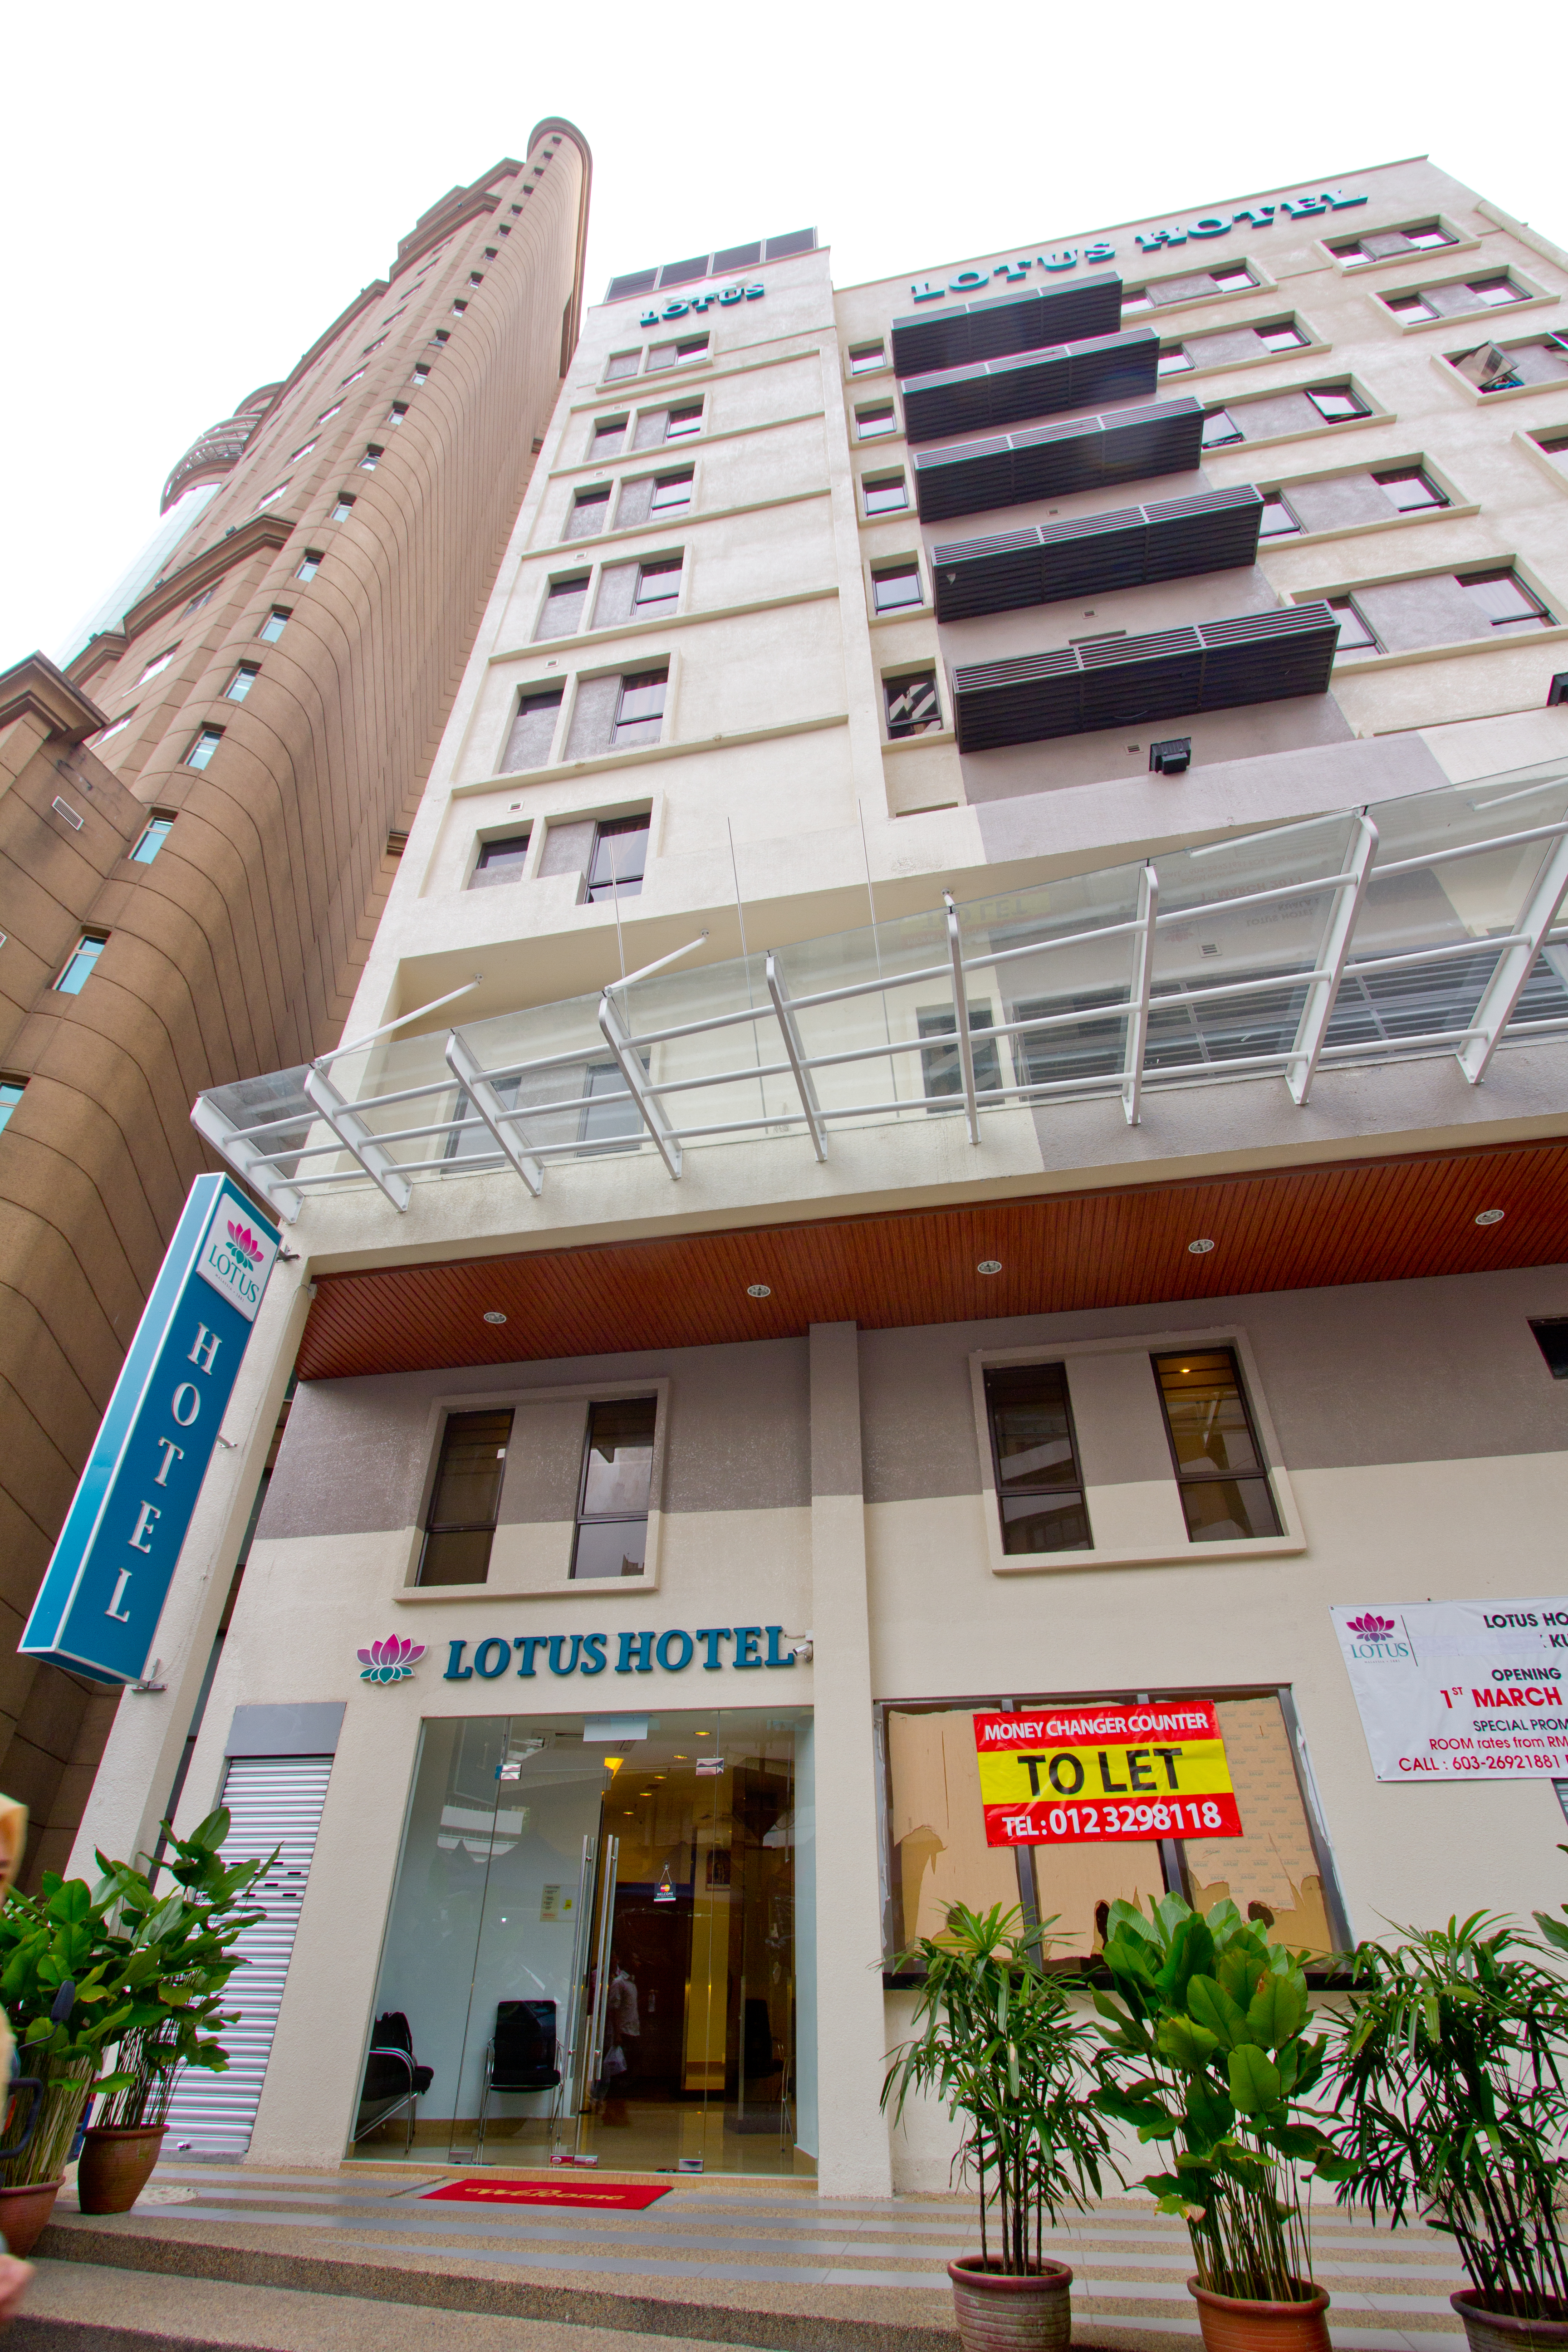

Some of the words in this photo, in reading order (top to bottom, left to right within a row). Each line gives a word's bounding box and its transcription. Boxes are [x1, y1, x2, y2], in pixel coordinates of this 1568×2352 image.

[911, 242, 1115, 304] LOTUS
[1135, 190, 1368, 253] HOTEL
[640, 284, 764, 328] LOTUS
[208, 1243, 260, 1303] LOTUS
[216, 1274, 233, 1291] MALAYSIA
[104, 1322, 223, 1622] HOTEL
[1483, 1613, 1538, 1628] LOTUS
[443, 1633, 607, 1680] LOTUS
[614, 1625, 795, 1672] HOTEL
[1350, 1642, 1408, 1658] LOTUS
[1492, 1667, 1561, 1681] OPENING
[1440, 1687, 1463, 1709] 1ST
[1471, 1686, 1563, 1707] MARCH
[985, 1721, 1043, 1740] MONEY
[1047, 1717, 1127, 1737] CHANGER
[1128, 1713, 1209, 1733] COUNTER
[1473, 1720, 1529, 1731] SPECIAL
[1429, 1738, 1474, 1750] ROOM
[1477, 1737, 1510, 1749] rates
[1513, 1736, 1544, 1748] from
[1547, 1736, 1568, 1747] RM
[1017, 1753, 1084, 1797] TO
[1098, 1748, 1182, 1793] LET
[1399, 1757, 1439, 1771] CALL
[1452, 1754, 1560, 1770] 603-26921881
[1049, 1807, 1100, 1836] 012
[1104, 1802, 1222, 1832] 3298118
[465, 2187, 626, 2200] Welcome
